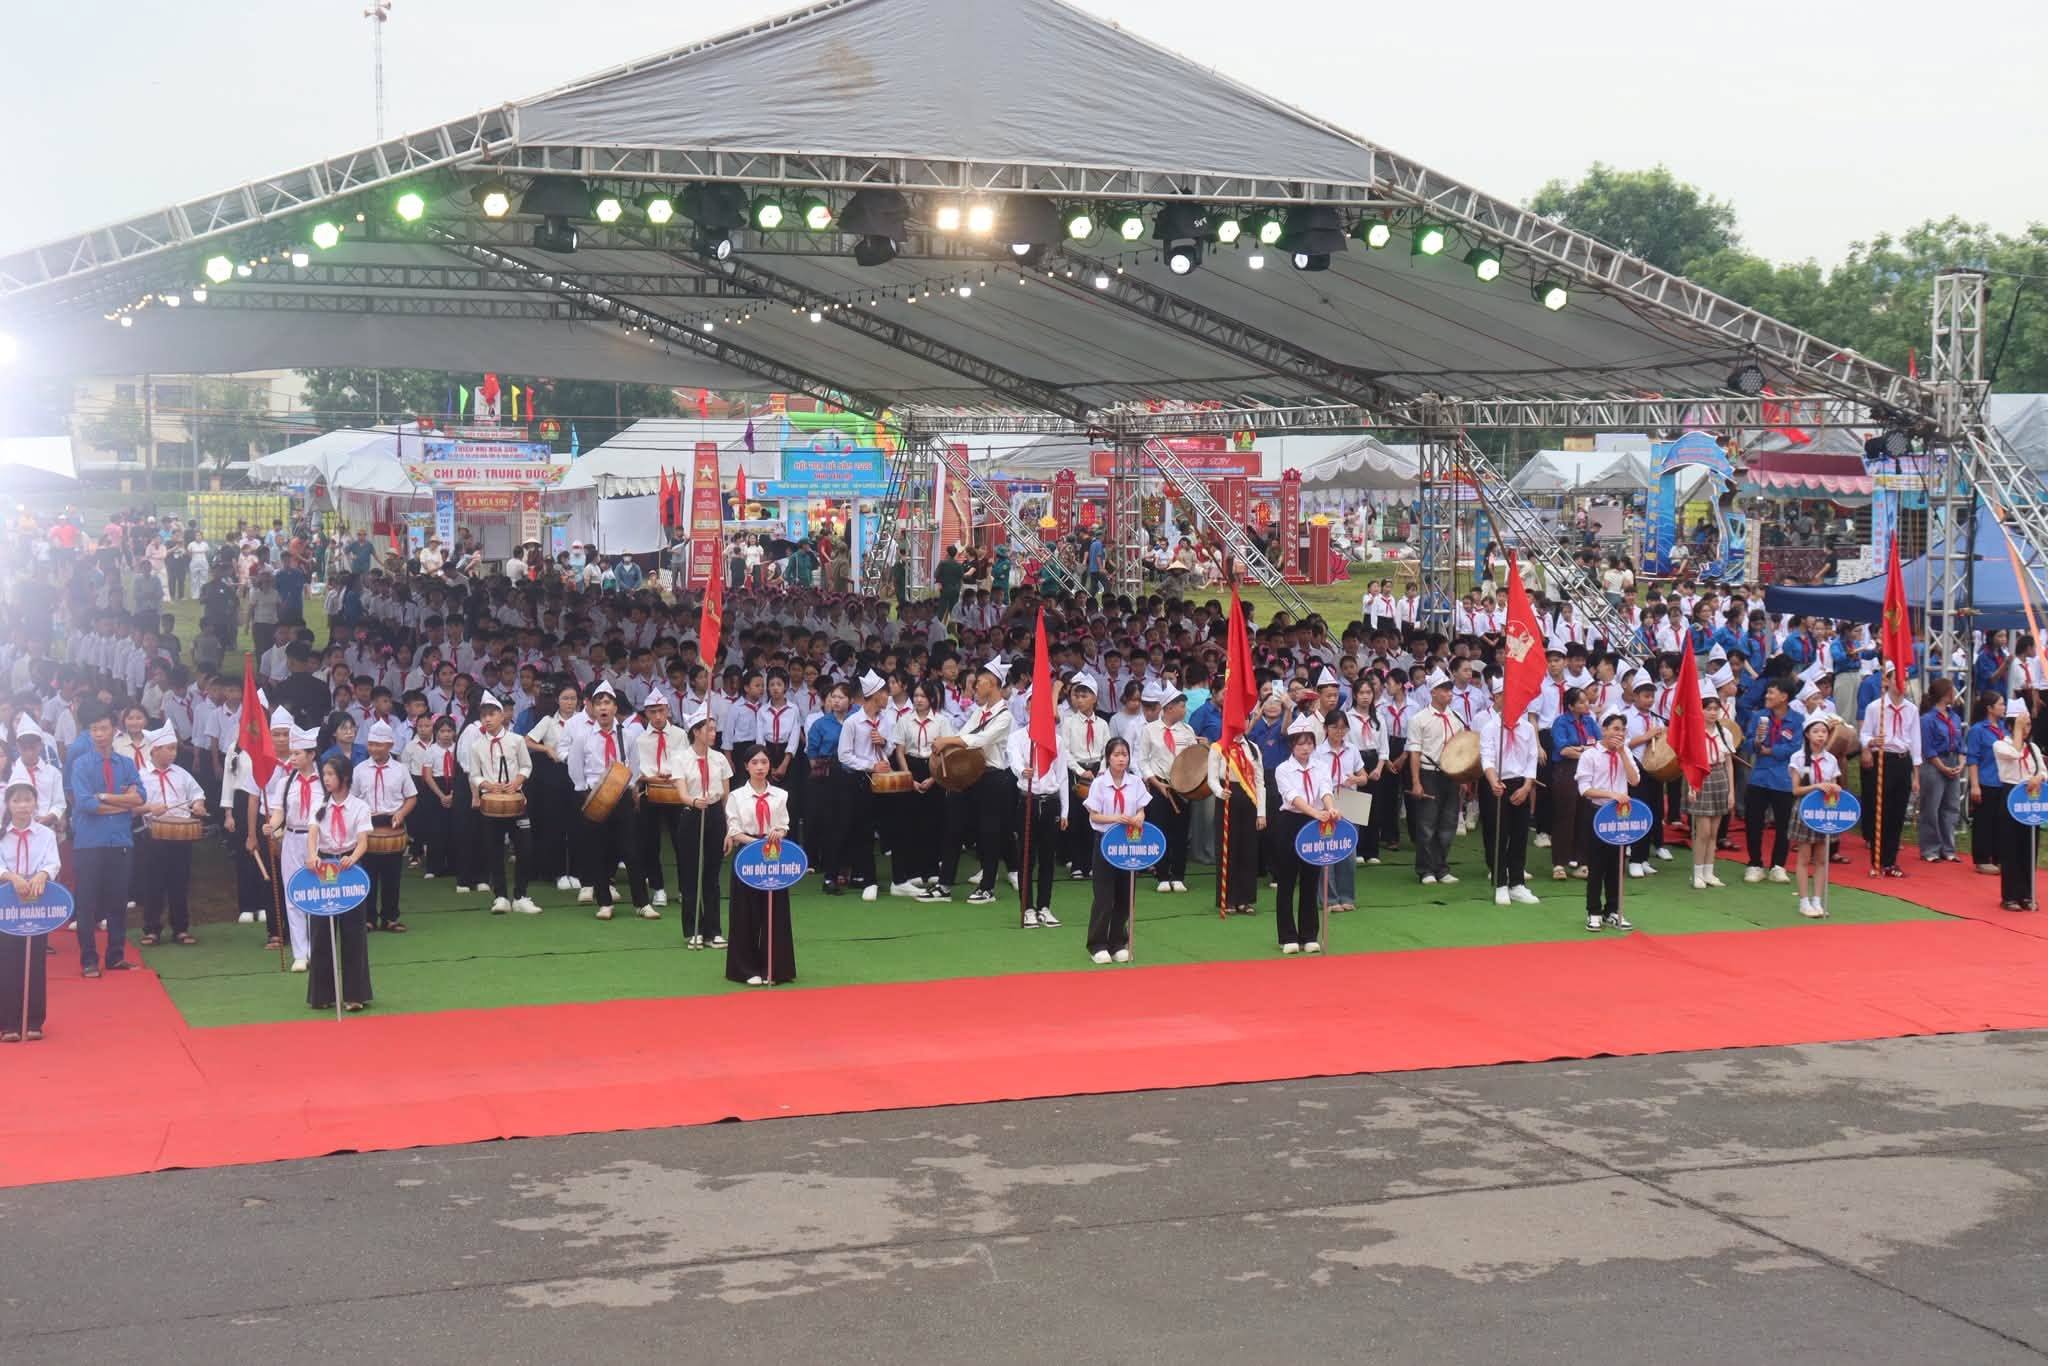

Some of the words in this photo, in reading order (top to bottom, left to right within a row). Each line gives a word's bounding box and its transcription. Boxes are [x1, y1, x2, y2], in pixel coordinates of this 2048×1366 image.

[433, 468, 453, 479] CHI
[457, 467, 481, 480] ĐỘI:
[484, 468, 522, 479] TRUNG
[1803, 809, 1814, 819] CHI
[1815, 808, 1826, 821] ĐỘI
[1599, 823, 1608, 832] CHI
[1107, 845, 1118, 856] CHI
[1118, 843, 1128, 857] ĐỘI
[1128, 845, 1147, 856] TRUNG
[1147, 842, 1160, 856] ĐỨC
[1302, 842, 1313, 853] CHI
[1314, 840, 1325, 854] ĐỘI
[1326, 838, 1338, 850] YÊN
[1339, 837, 1352, 851] LỘC
[742, 864, 754, 876] CHI
[754, 863, 767, 877] ĐỘI
[781, 862, 801, 877] THIỆN
[293, 889, 306, 902] CHI
[307, 886, 320, 903] ĐỘI
[5, 904, 17, 920] ĐỘI
[19, 903, 46, 920] HOÀNG
[47, 905, 68, 919] LONG
